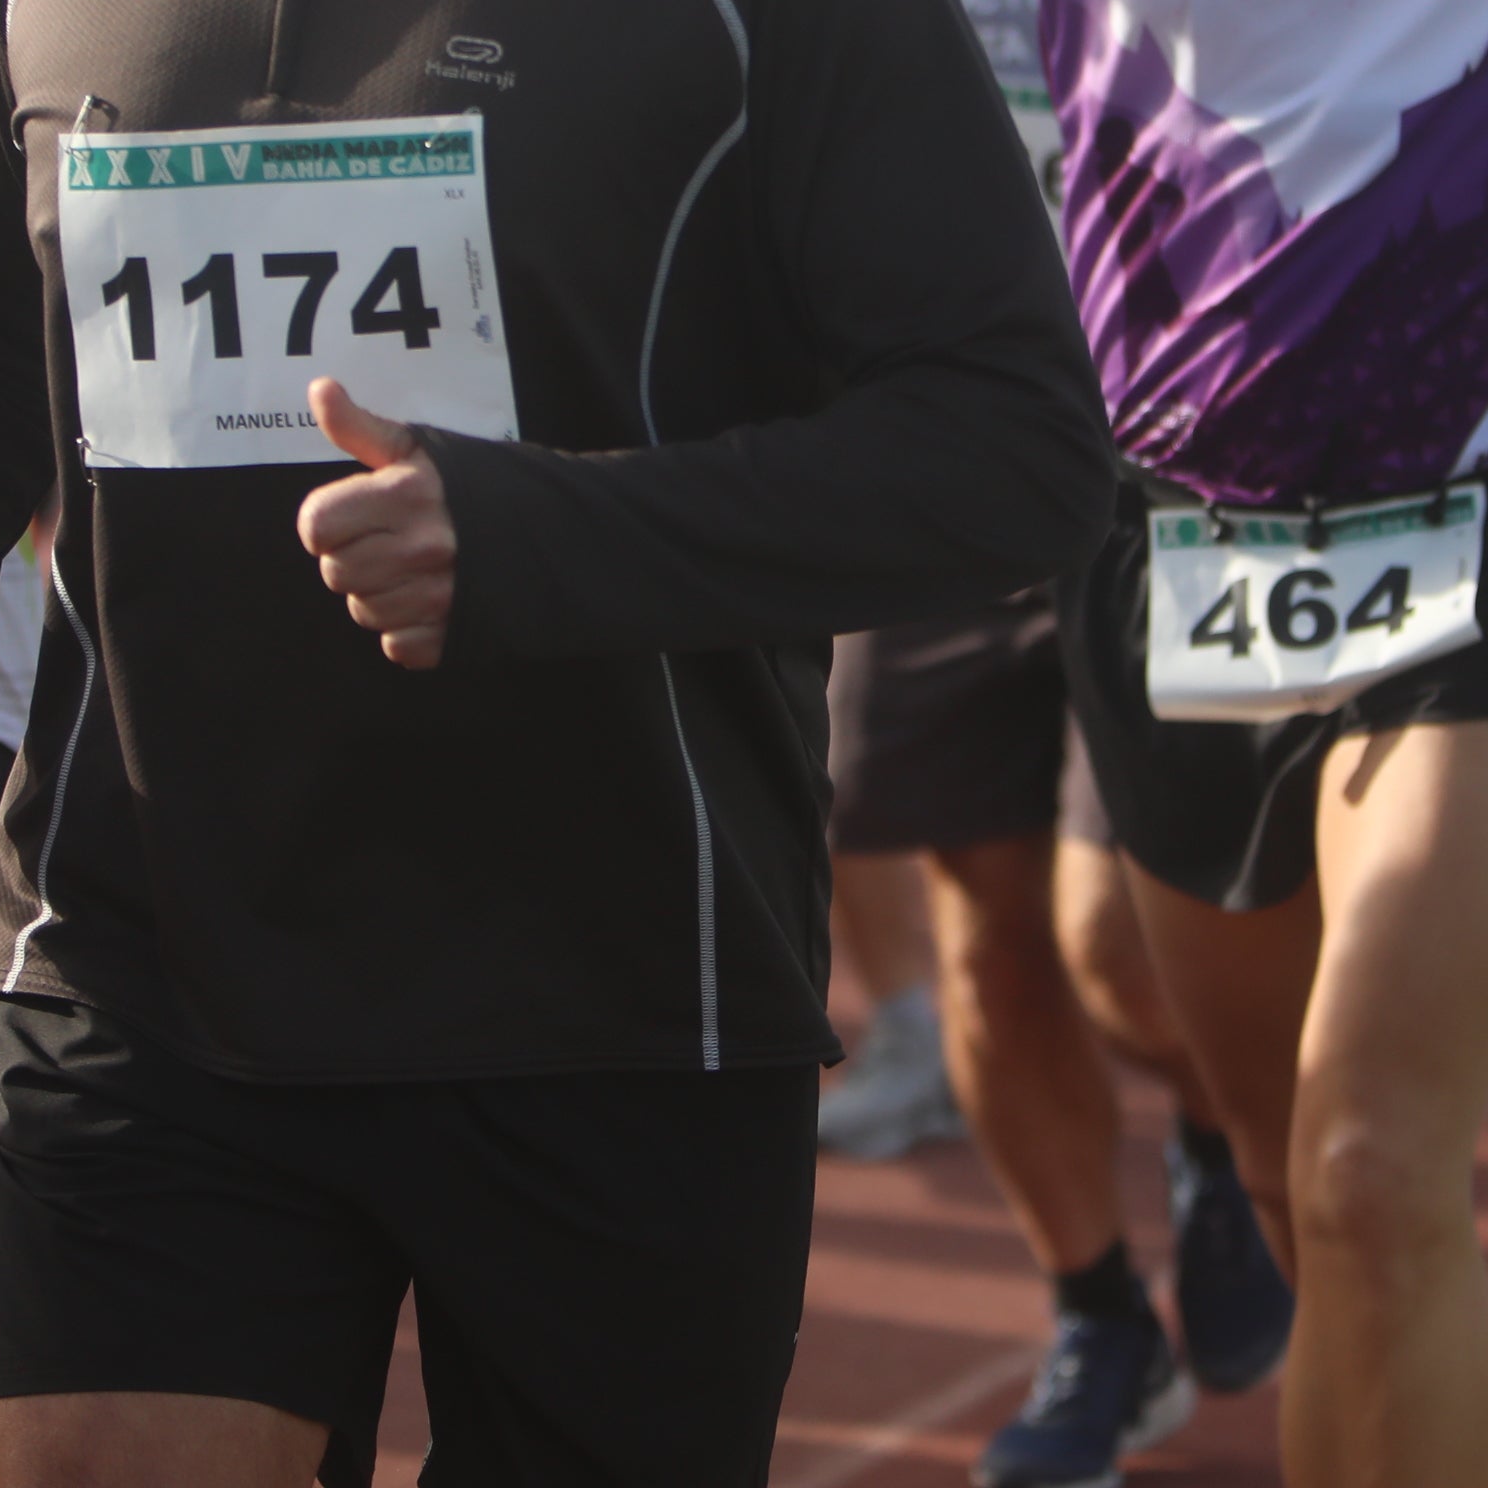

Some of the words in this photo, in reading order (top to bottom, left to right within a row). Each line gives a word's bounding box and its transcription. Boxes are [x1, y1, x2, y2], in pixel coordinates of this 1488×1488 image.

[70, 143, 252, 187] XXXIV
[262, 142, 338, 161] MEDIA
[262, 157, 342, 180] BAHÍA
[349, 158, 382, 176] DE
[388, 153, 471, 174] CÁDIZ
[101, 246, 441, 361] 1174
[216, 412, 293, 430] MANUEL
[298, 412, 318, 427] LU
[1190, 565, 1414, 658] 464
